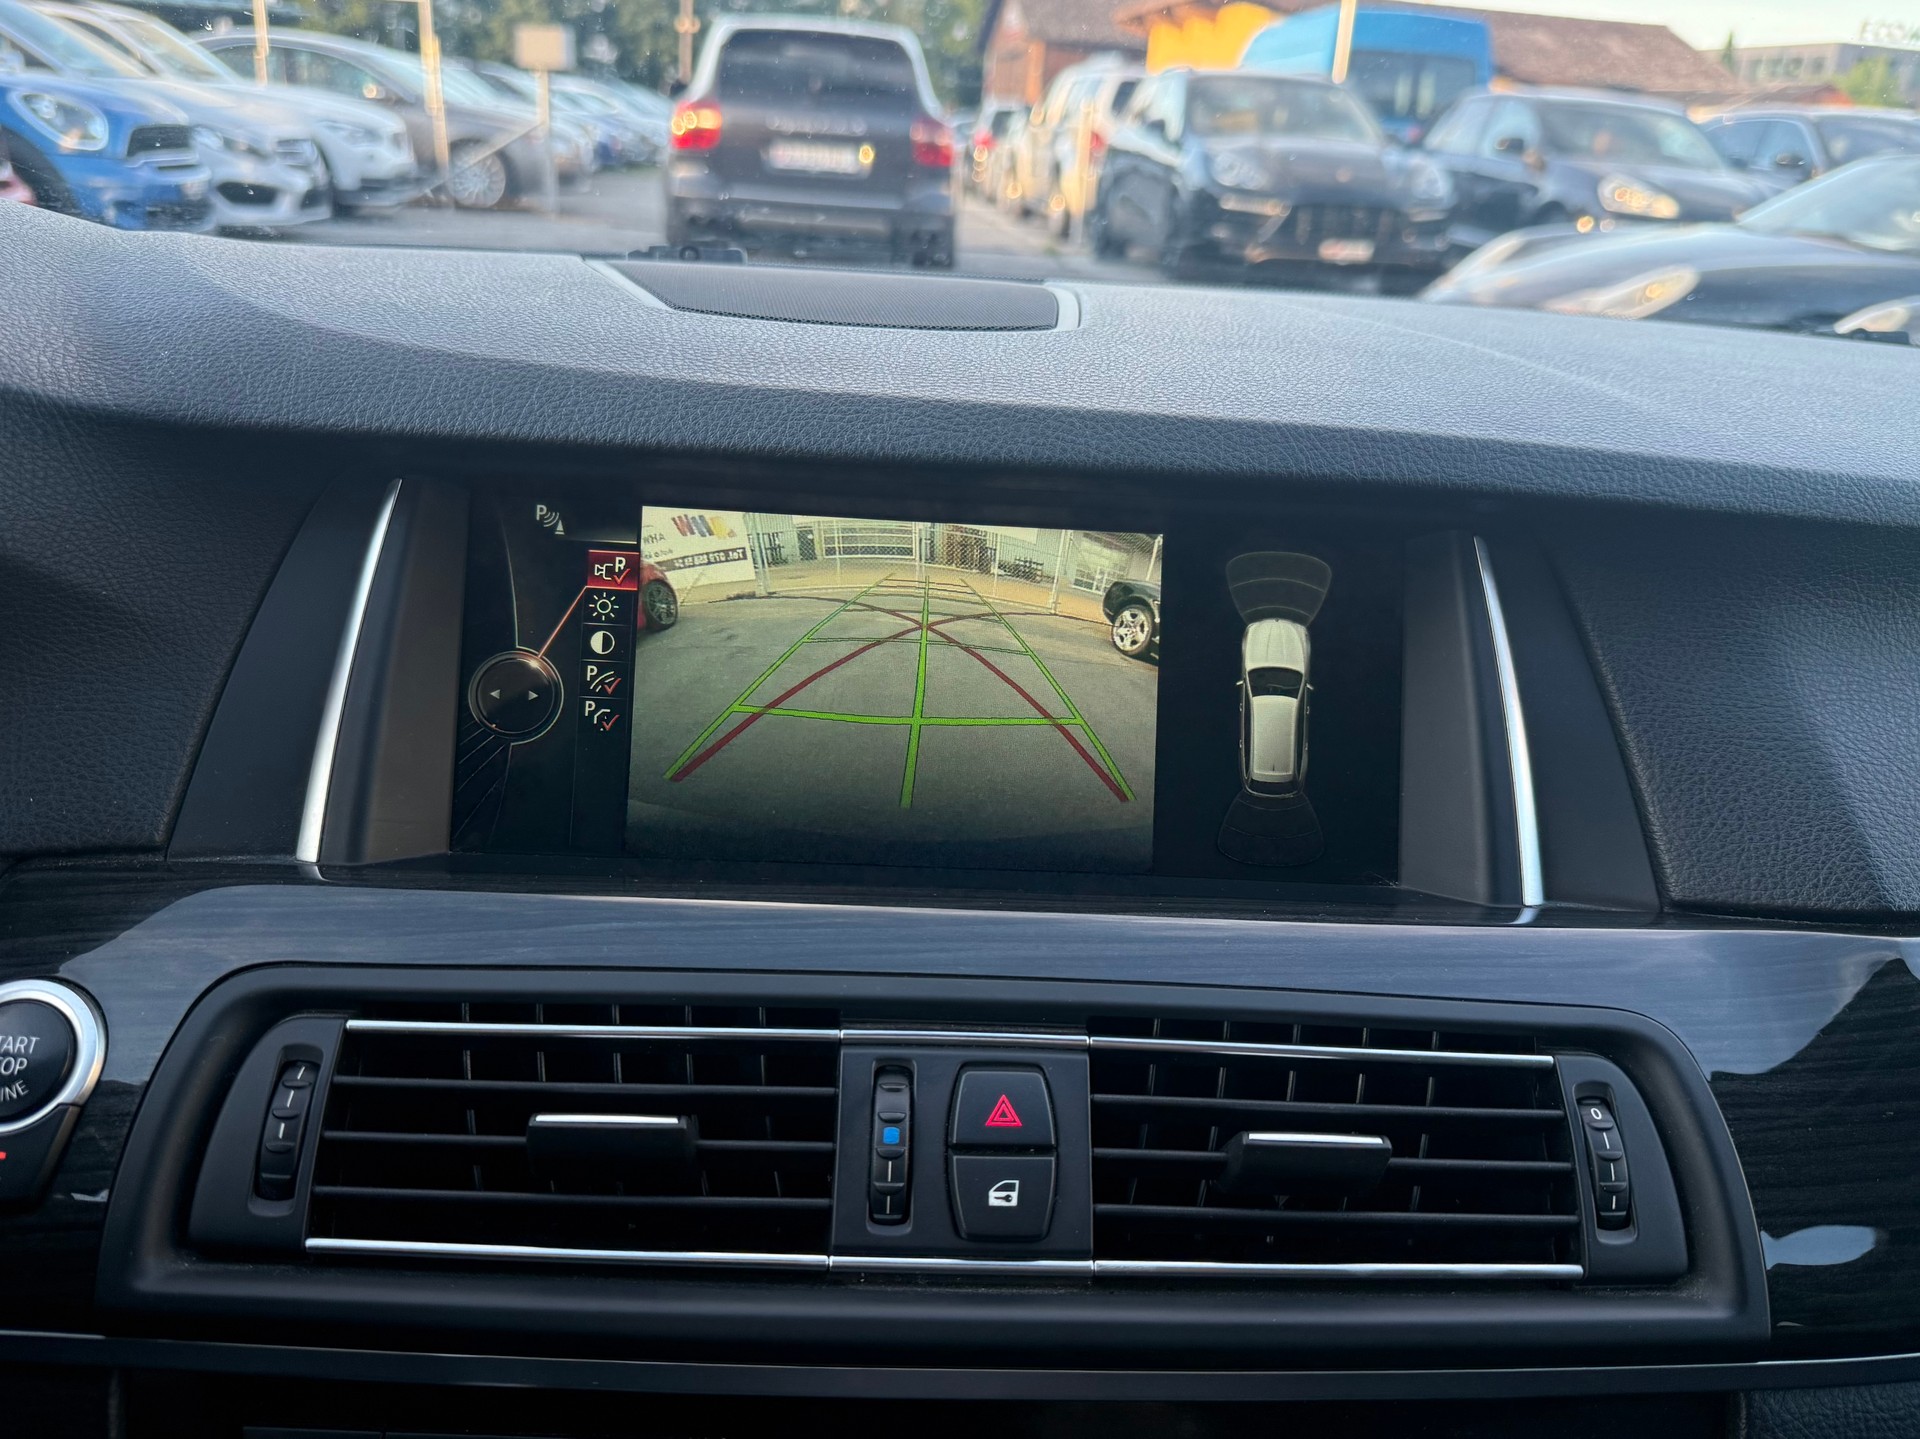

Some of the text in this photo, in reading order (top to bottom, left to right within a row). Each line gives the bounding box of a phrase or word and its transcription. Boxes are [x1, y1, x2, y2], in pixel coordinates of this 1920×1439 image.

[536, 504, 547, 521] P
[586, 665, 598, 682] P
[584, 700, 596, 717] P
